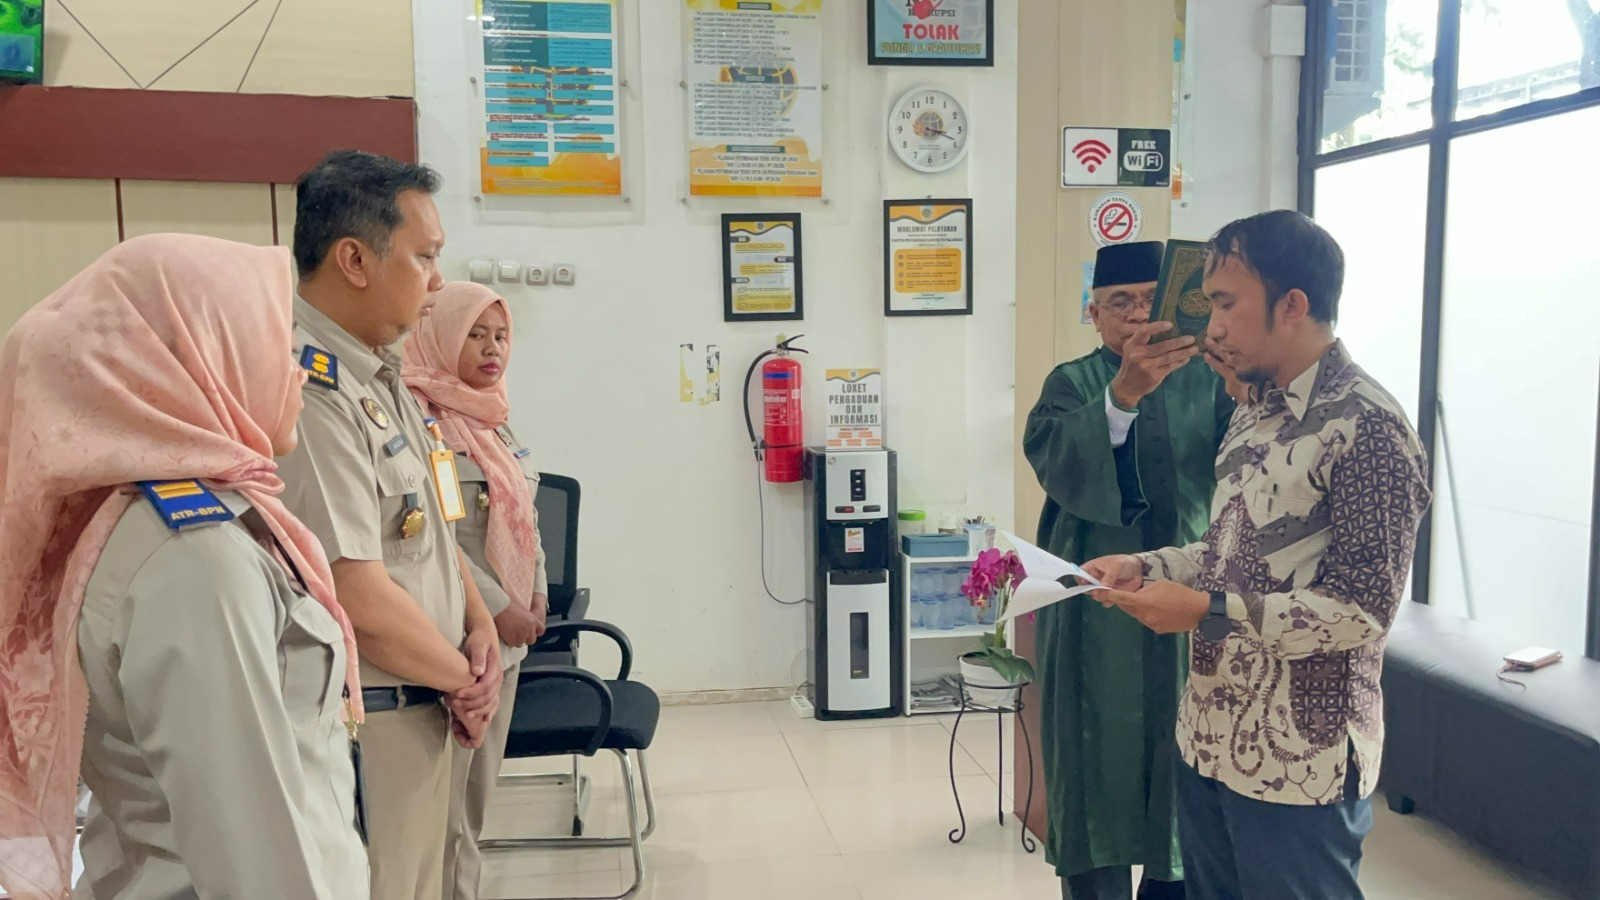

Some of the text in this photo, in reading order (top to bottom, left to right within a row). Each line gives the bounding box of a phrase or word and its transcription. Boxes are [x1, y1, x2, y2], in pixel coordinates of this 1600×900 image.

[908, 9, 956, 17] KRUPSI
[902, 24, 960, 40] TOLAK
[881, 42, 982, 54] PUNGLI & GRATIFIKASI
[912, 100, 920, 109] 11
[925, 96, 935, 104] 12
[943, 101, 947, 109] 1
[902, 111, 911, 119] 10
[952, 111, 957, 120] 2
[897, 125, 903, 134] 9
[957, 126, 962, 135] 3
[902, 140, 907, 149] 8
[1131, 140, 1157, 150] FREE
[913, 151, 918, 159] 7
[927, 155, 933, 164] 6
[943, 151, 948, 160] 5
[842, 383, 867, 393] LOKET
[829, 394, 879, 404] PENGADUAN
[845, 404, 863, 414] DAN
[830, 414, 878, 424] INFORMASI
[171, 506, 227, 520] ATR-BPN
